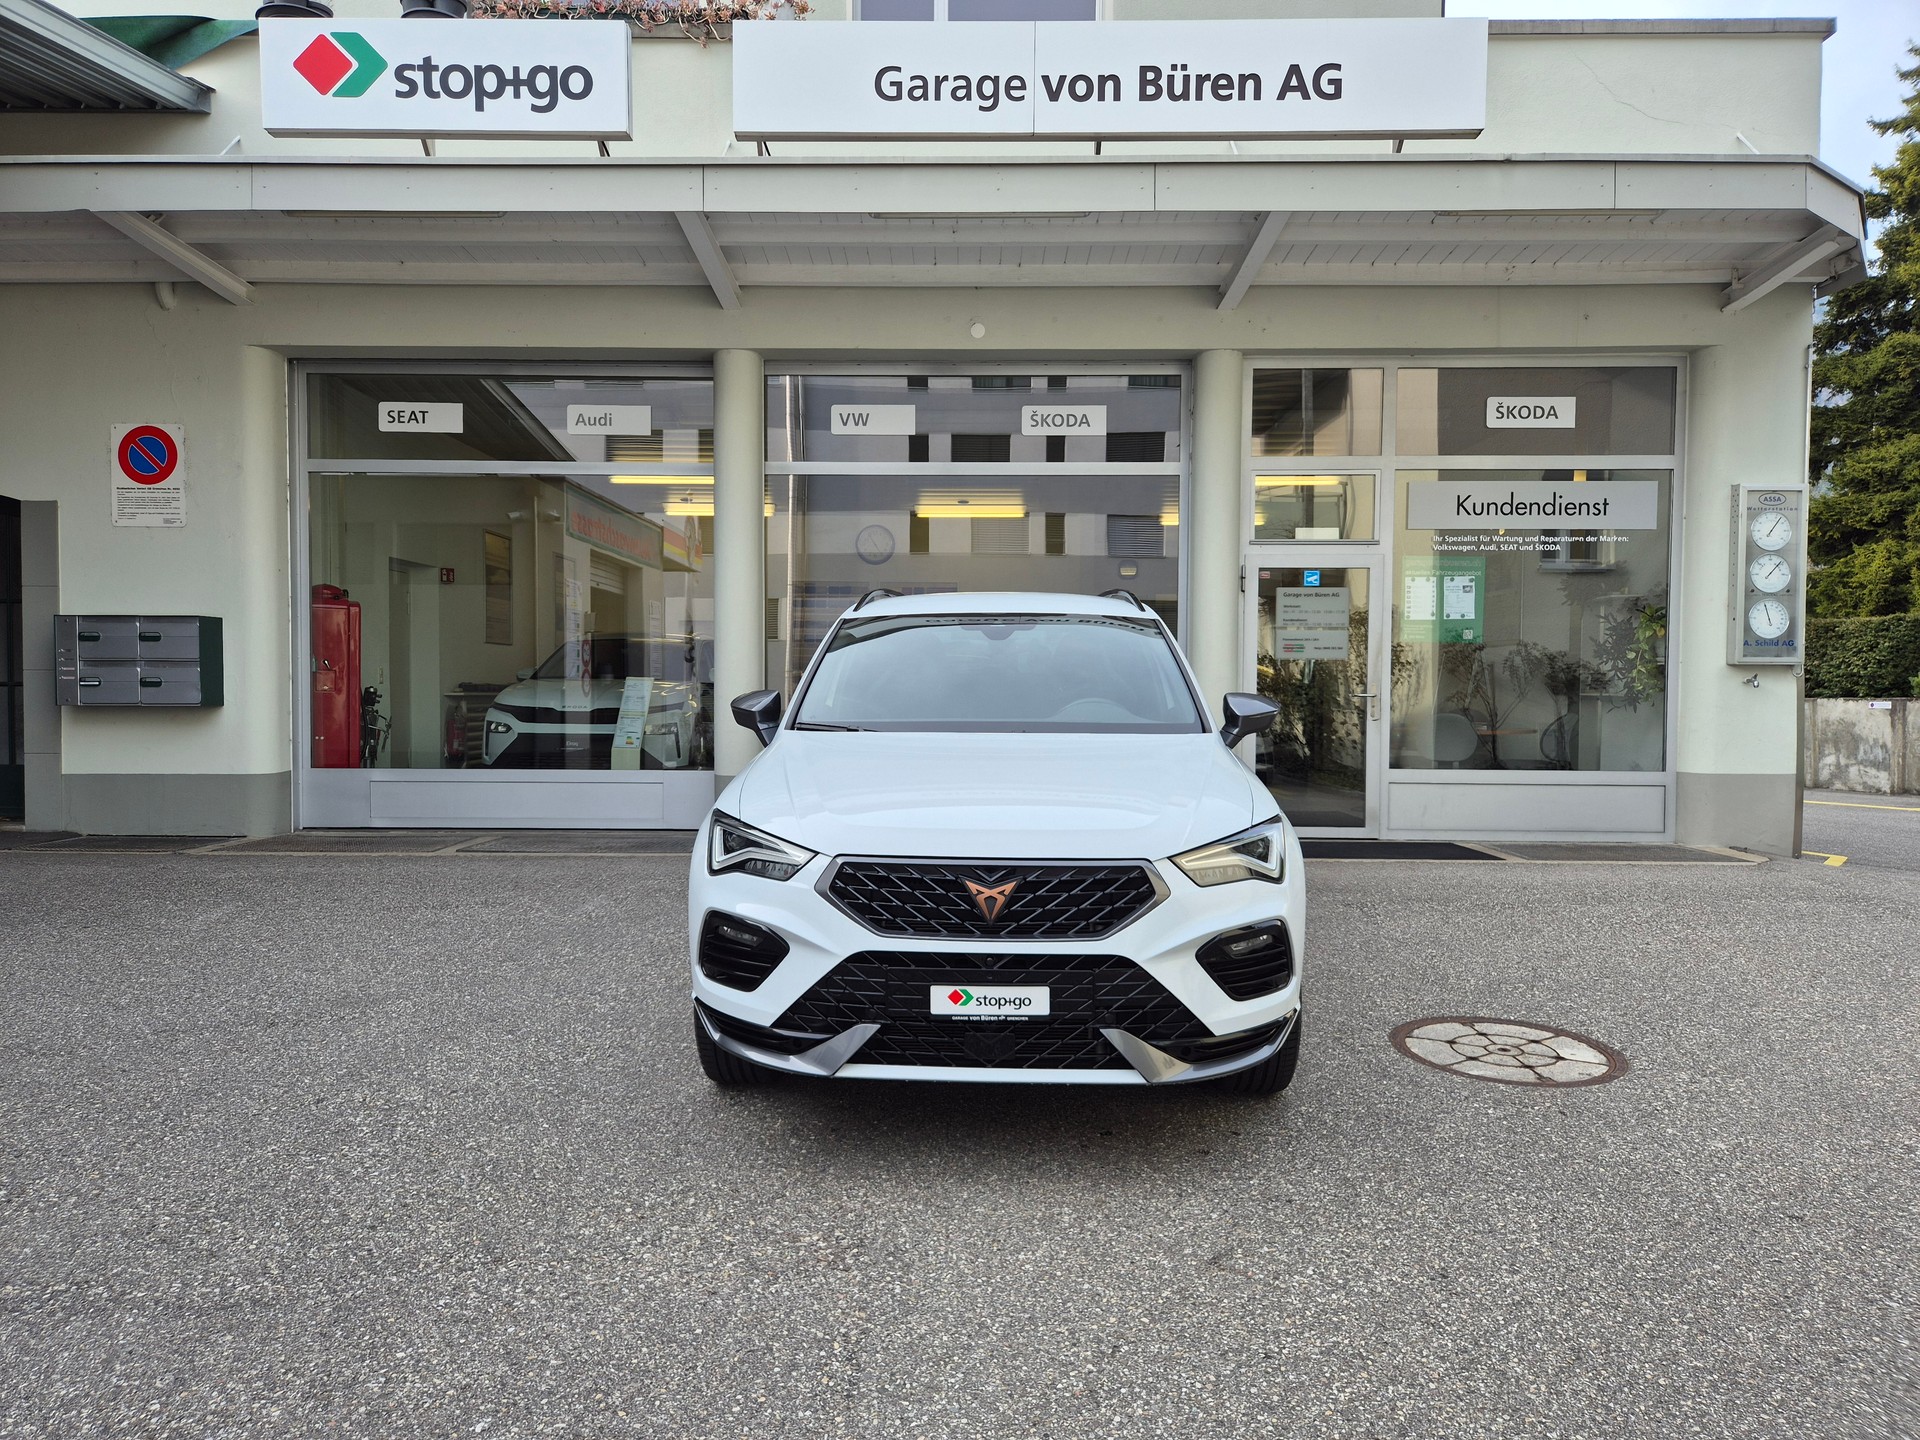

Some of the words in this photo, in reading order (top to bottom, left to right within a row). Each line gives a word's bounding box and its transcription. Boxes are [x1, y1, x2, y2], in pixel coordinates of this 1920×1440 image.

[394, 56, 594, 113] stop+go
[874, 65, 1027, 112] Garage
[1041, 74, 1122, 102] von
[1138, 63, 1262, 102] Büren
[1276, 62, 1344, 101] AG
[387, 410, 429, 424] SEAT
[1495, 402, 1559, 420] ŠKODA
[575, 412, 612, 427] Audi
[838, 413, 870, 427] VW
[1029, 411, 1091, 428] ŠKODA
[1456, 491, 1610, 516] Kundendienst
[1444, 535, 1478, 543] Spezialist
[1492, 535, 1523, 543] Wartung
[1540, 535, 1584, 543] Reparaturen
[1433, 543, 1478, 553] Volkswagen,
[1479, 543, 1498, 552] Audi,
[1519, 543, 1533, 551] und
[1535, 542, 1561, 551] ŠKODA
[1755, 639, 1780, 647] Schild
[1782, 639, 1795, 647] AG
[975, 995, 1032, 1010] stop+go
